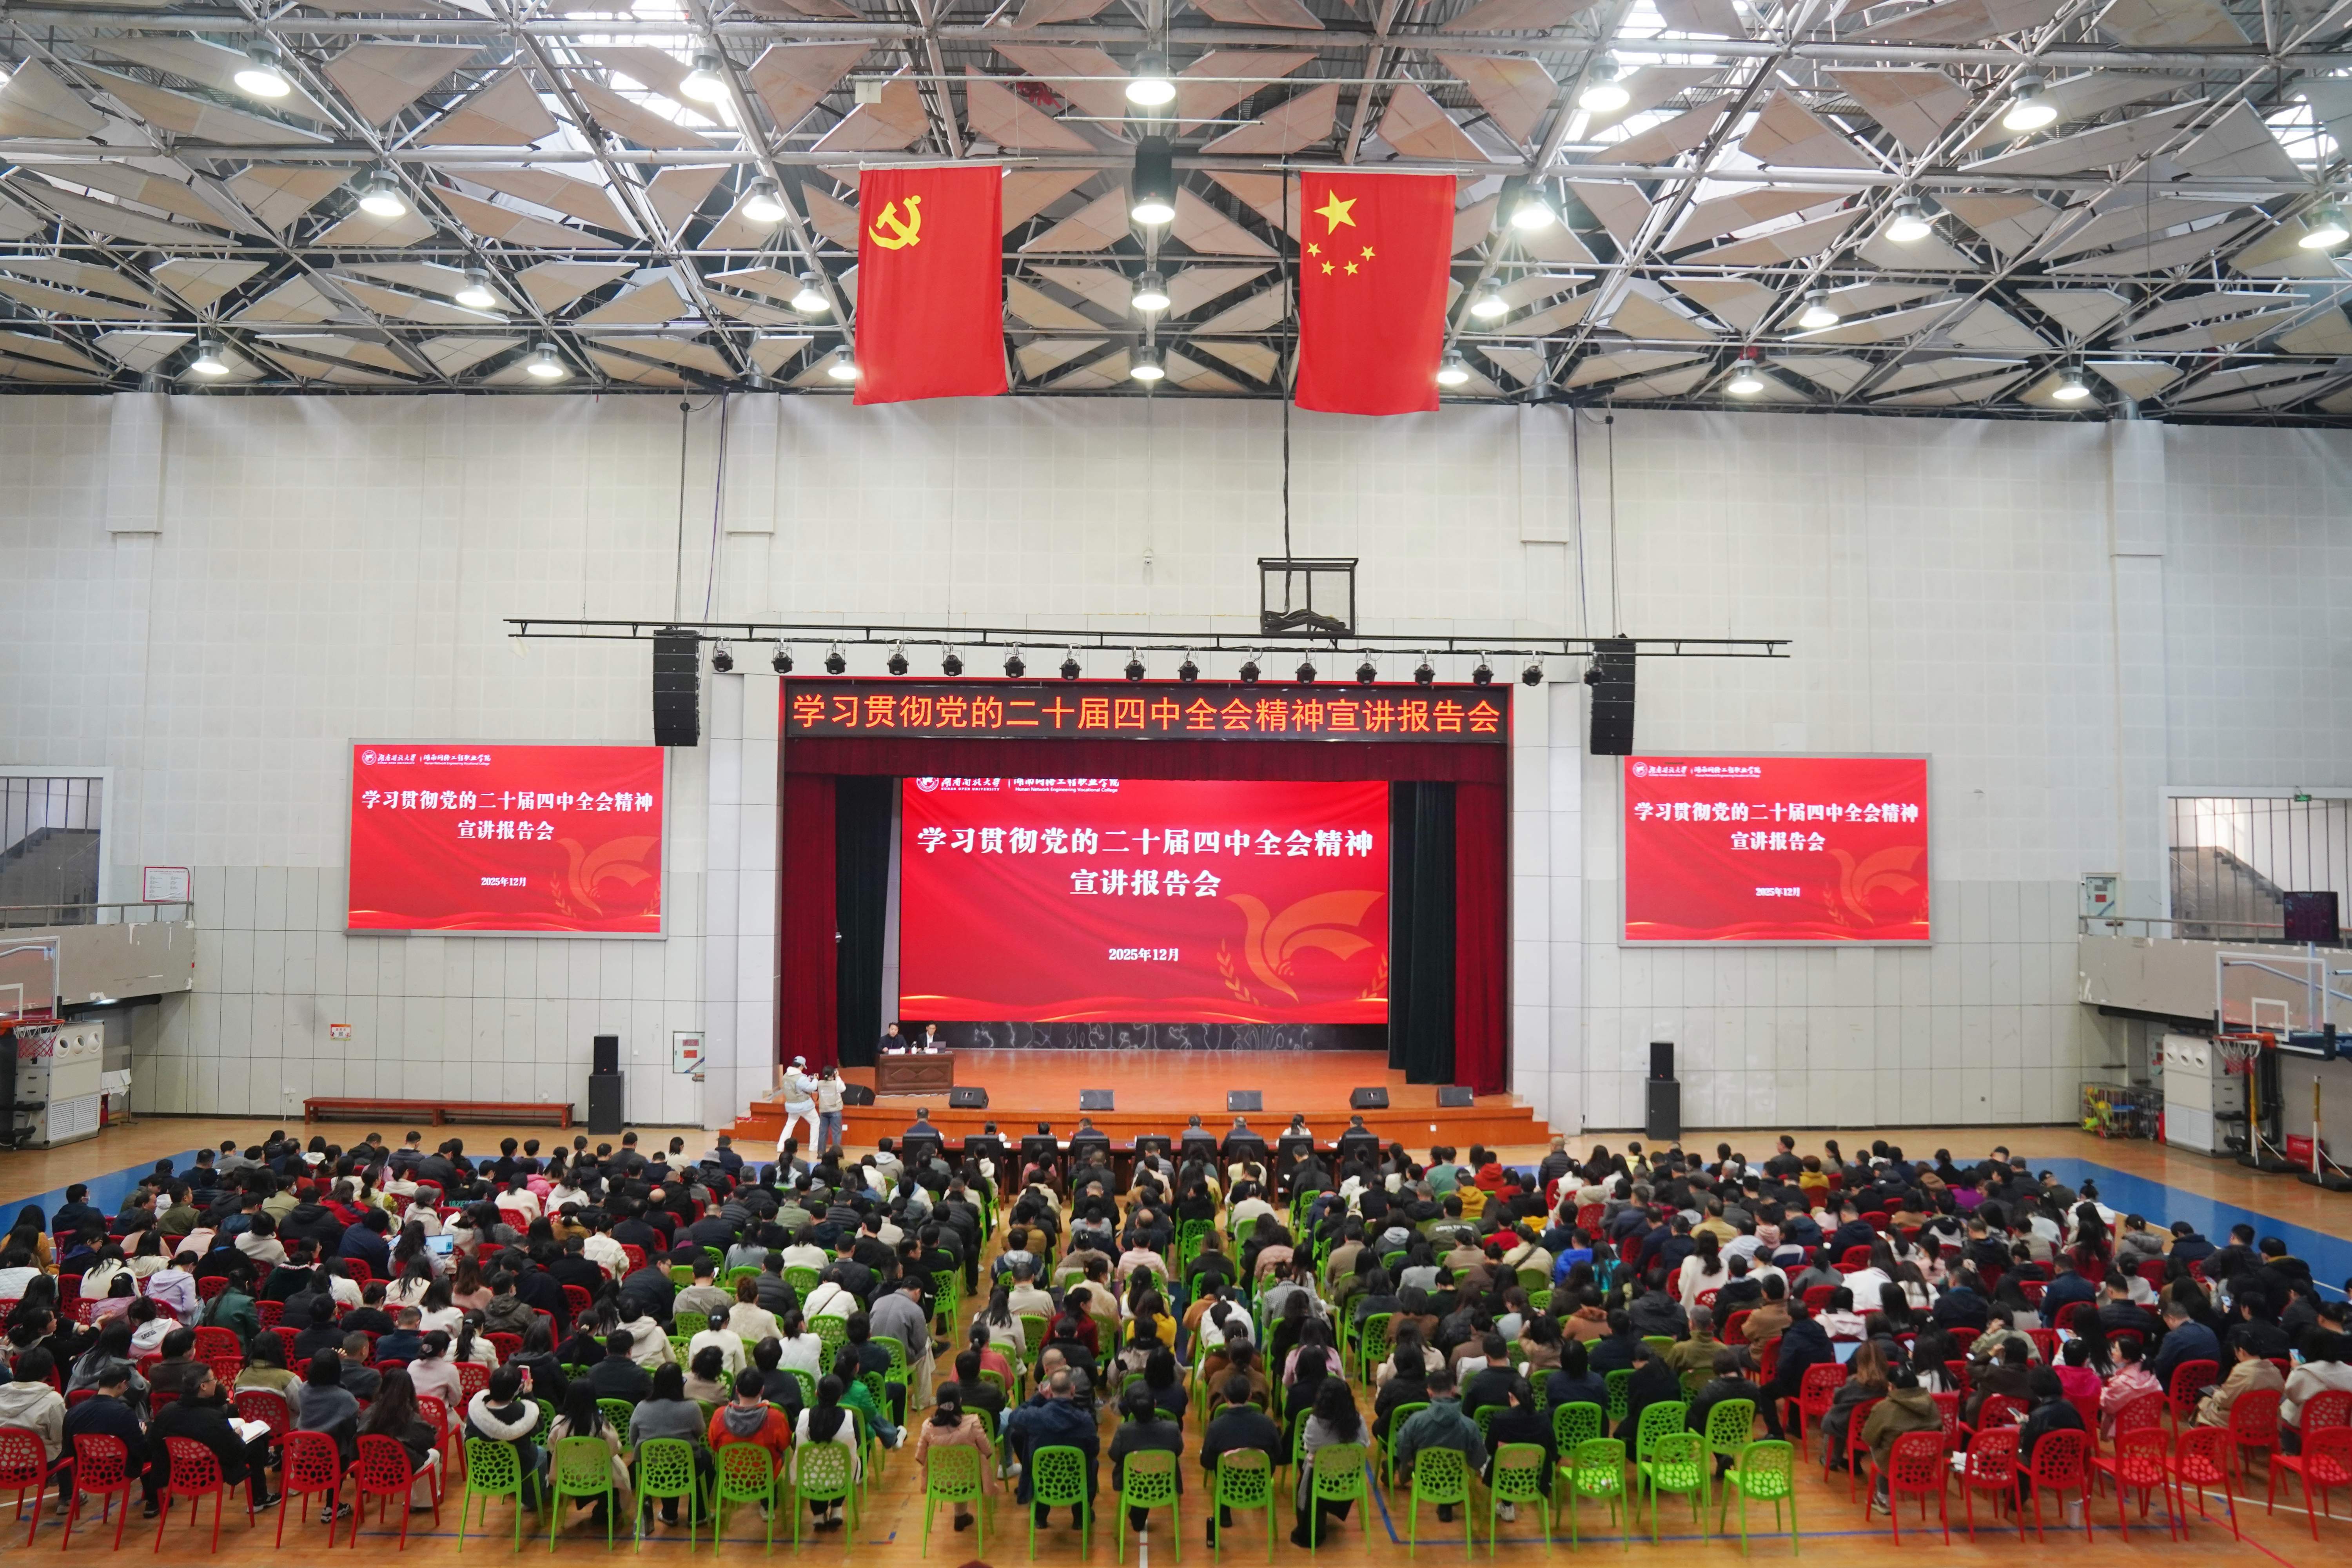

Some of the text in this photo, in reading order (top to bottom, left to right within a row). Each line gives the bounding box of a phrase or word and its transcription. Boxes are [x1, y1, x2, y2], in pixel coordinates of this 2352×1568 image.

[793, 694, 1500, 733] 学习贯彻党的二十届四中全会精神宣讲报告会
[361, 790, 653, 813] 学习贯彻党的二十届四中全会精神
[1634, 802, 1919, 823] 学习贯彻党的二十届四中全会精神
[457, 820, 555, 840] 宣讲报告会
[917, 827, 1373, 857] 学习贯彻党的二十届四中全会精神
[1731, 831, 1826, 851] 宣讲报告会
[481, 877, 526, 887] 2025年12月
[1069, 868, 1221, 897] 宣讲报告会
[1755, 887, 1800, 897] 2025年12月
[1109, 947, 1179, 962] 2025年12月
